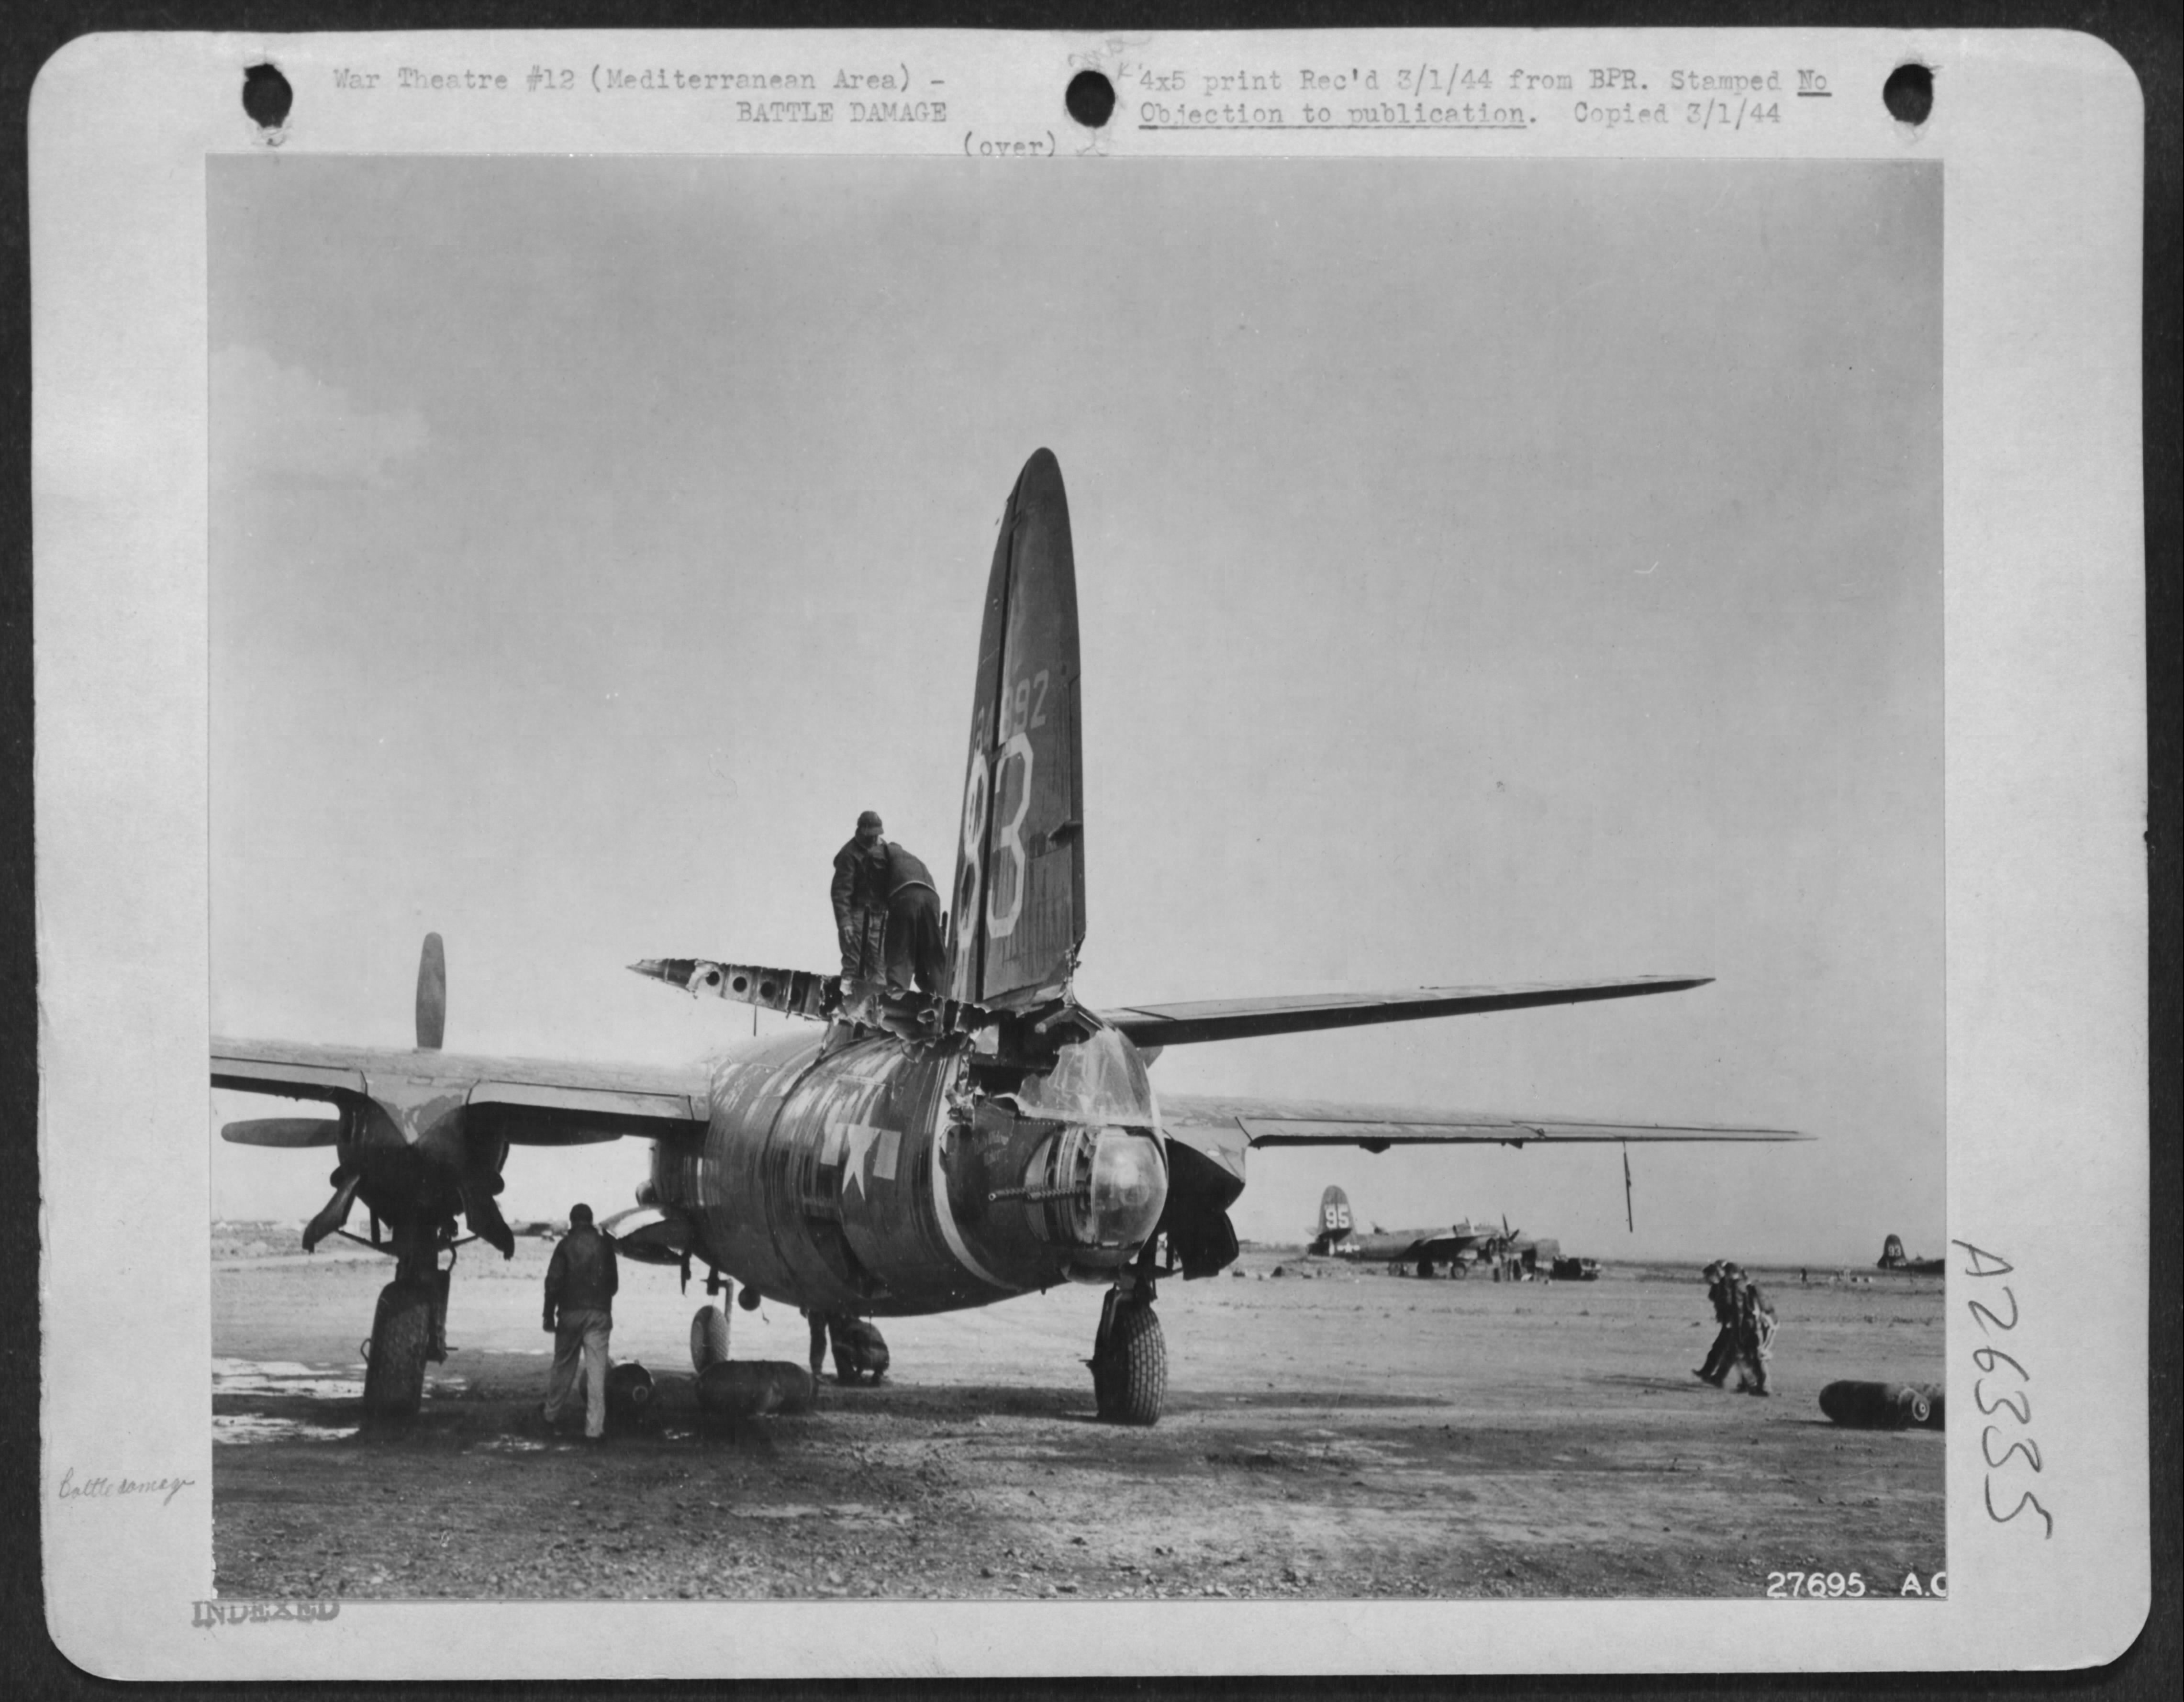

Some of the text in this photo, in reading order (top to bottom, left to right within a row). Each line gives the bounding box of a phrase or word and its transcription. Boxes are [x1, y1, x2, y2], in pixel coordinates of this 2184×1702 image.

[333, 67, 380, 89] War
[398, 67, 508, 89] Theatre
[527, 65, 575, 91] #12
[591, 64, 816, 93] (Mediterranean
[833, 63, 910, 93] Area)
[1139, 63, 1827, 96] 4x5 print Rec'd 3/1/44 from BPR. Stamped No
[736, 101, 947, 122] BATTLE DAMAGE
[1139, 98, 1781, 130] Objection to publication. Copied 3/1/44
[964, 131, 1056, 156] (over)
[1325, 1203, 1349, 1229] 95
[1887, 1244, 1902, 1257] 93
[1951, 1239, 2053, 1540] A26335
[191, 1600, 340, 1627] INDEXED
